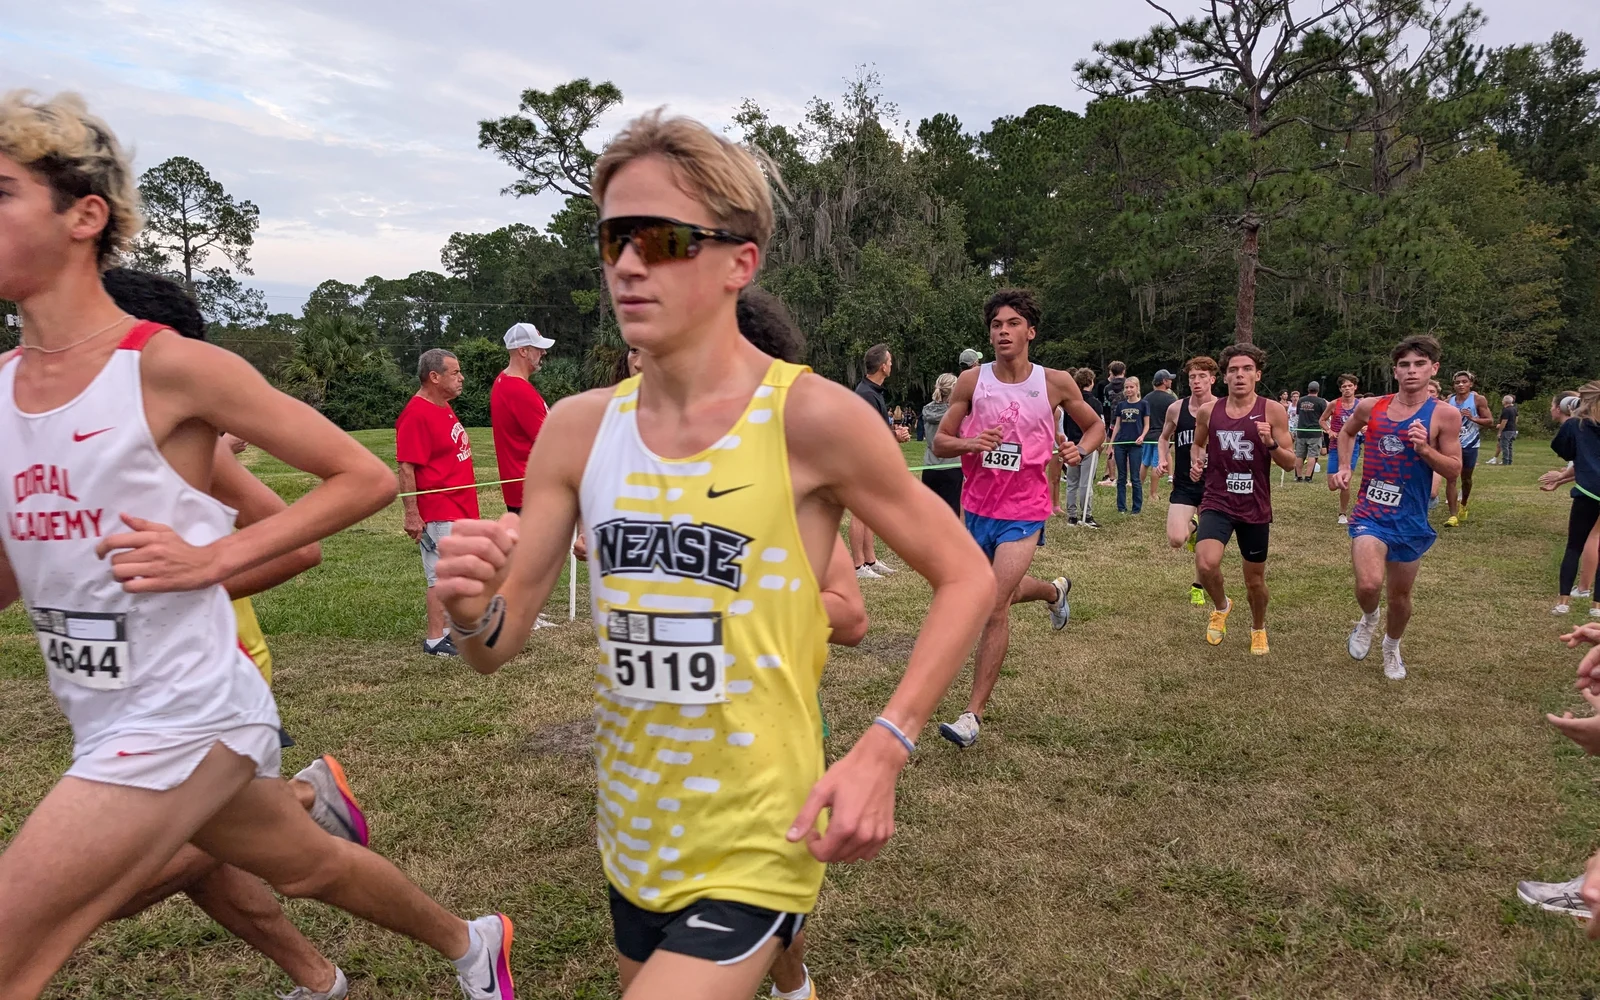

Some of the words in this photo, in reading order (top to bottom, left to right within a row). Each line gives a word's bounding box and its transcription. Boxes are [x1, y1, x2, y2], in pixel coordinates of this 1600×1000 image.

[1178, 430, 1193, 447] KNI
[985, 453, 1018, 467] 4387
[1228, 481, 1251, 490] 5684
[1368, 488, 1399, 504] 4337
[592, 517, 755, 592] NEASE
[48, 639, 121, 678] 4644
[614, 647, 716, 692] 5119
